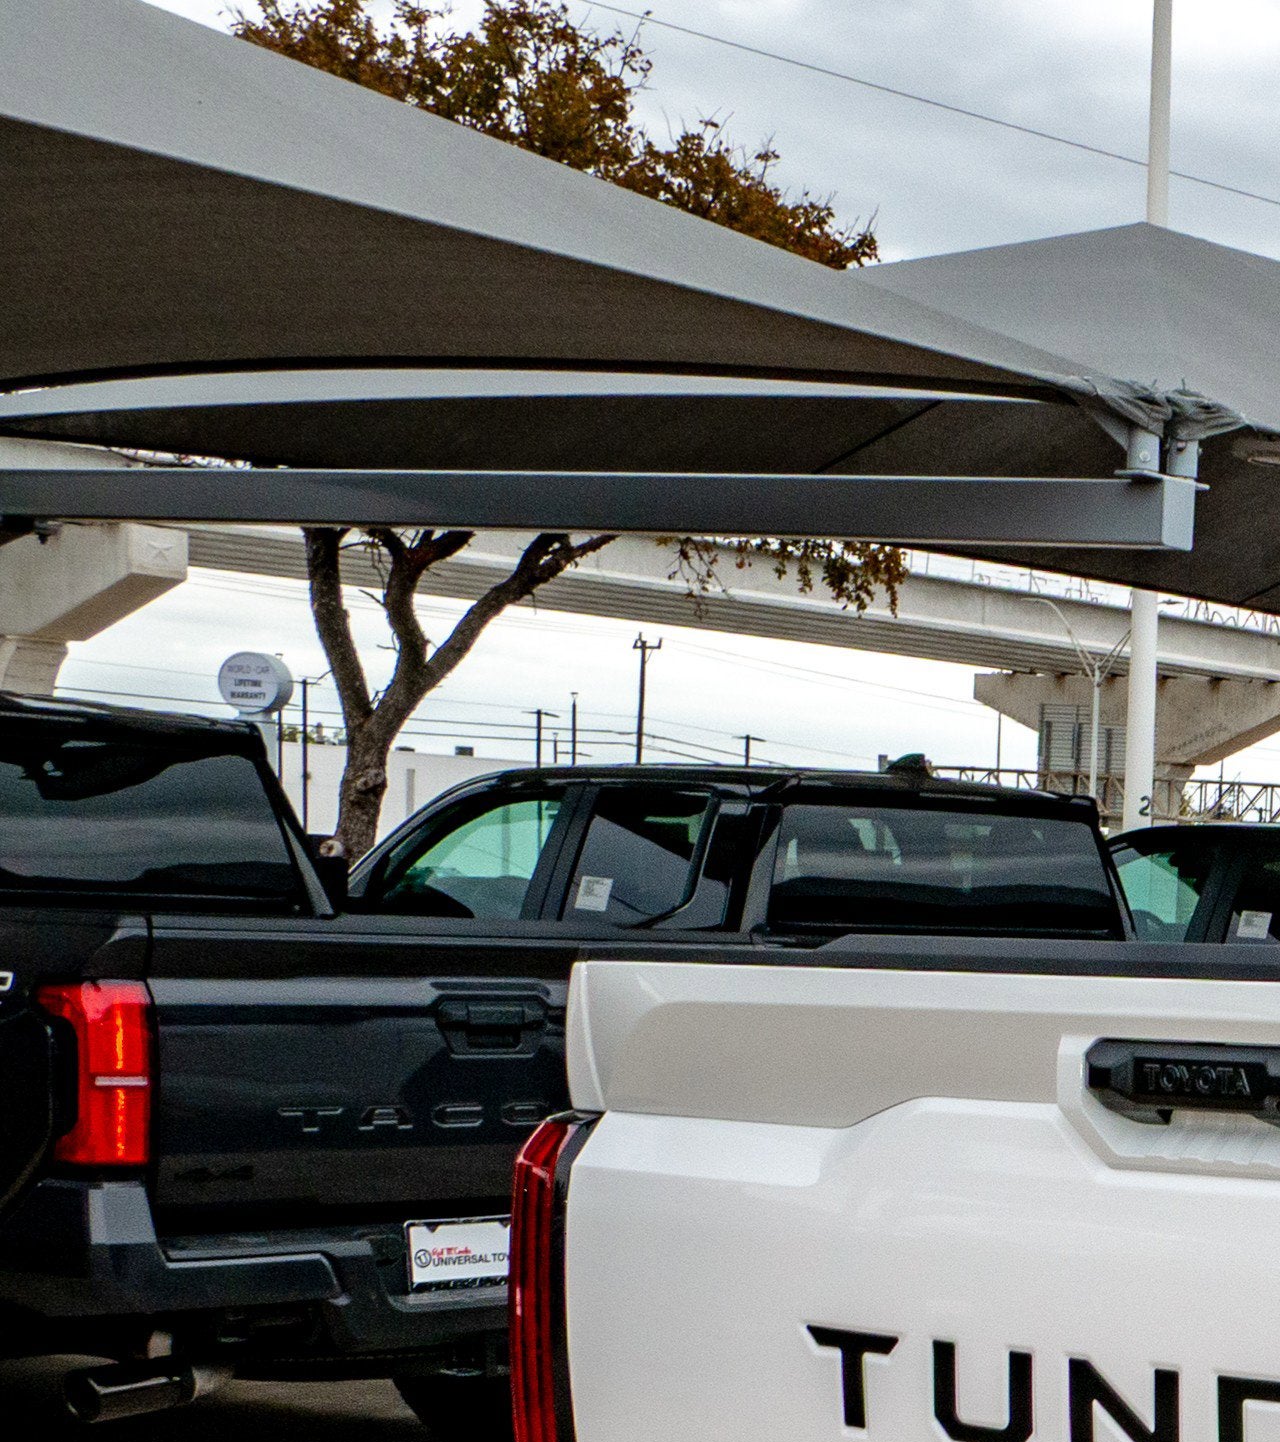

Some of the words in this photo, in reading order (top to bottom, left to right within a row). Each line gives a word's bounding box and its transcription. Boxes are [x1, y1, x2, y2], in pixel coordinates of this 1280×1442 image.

[1139, 795, 1151, 816] 2
[1143, 1063, 1252, 1096] TOYOTA
[432, 1253, 489, 1267] UNIVERSAL
